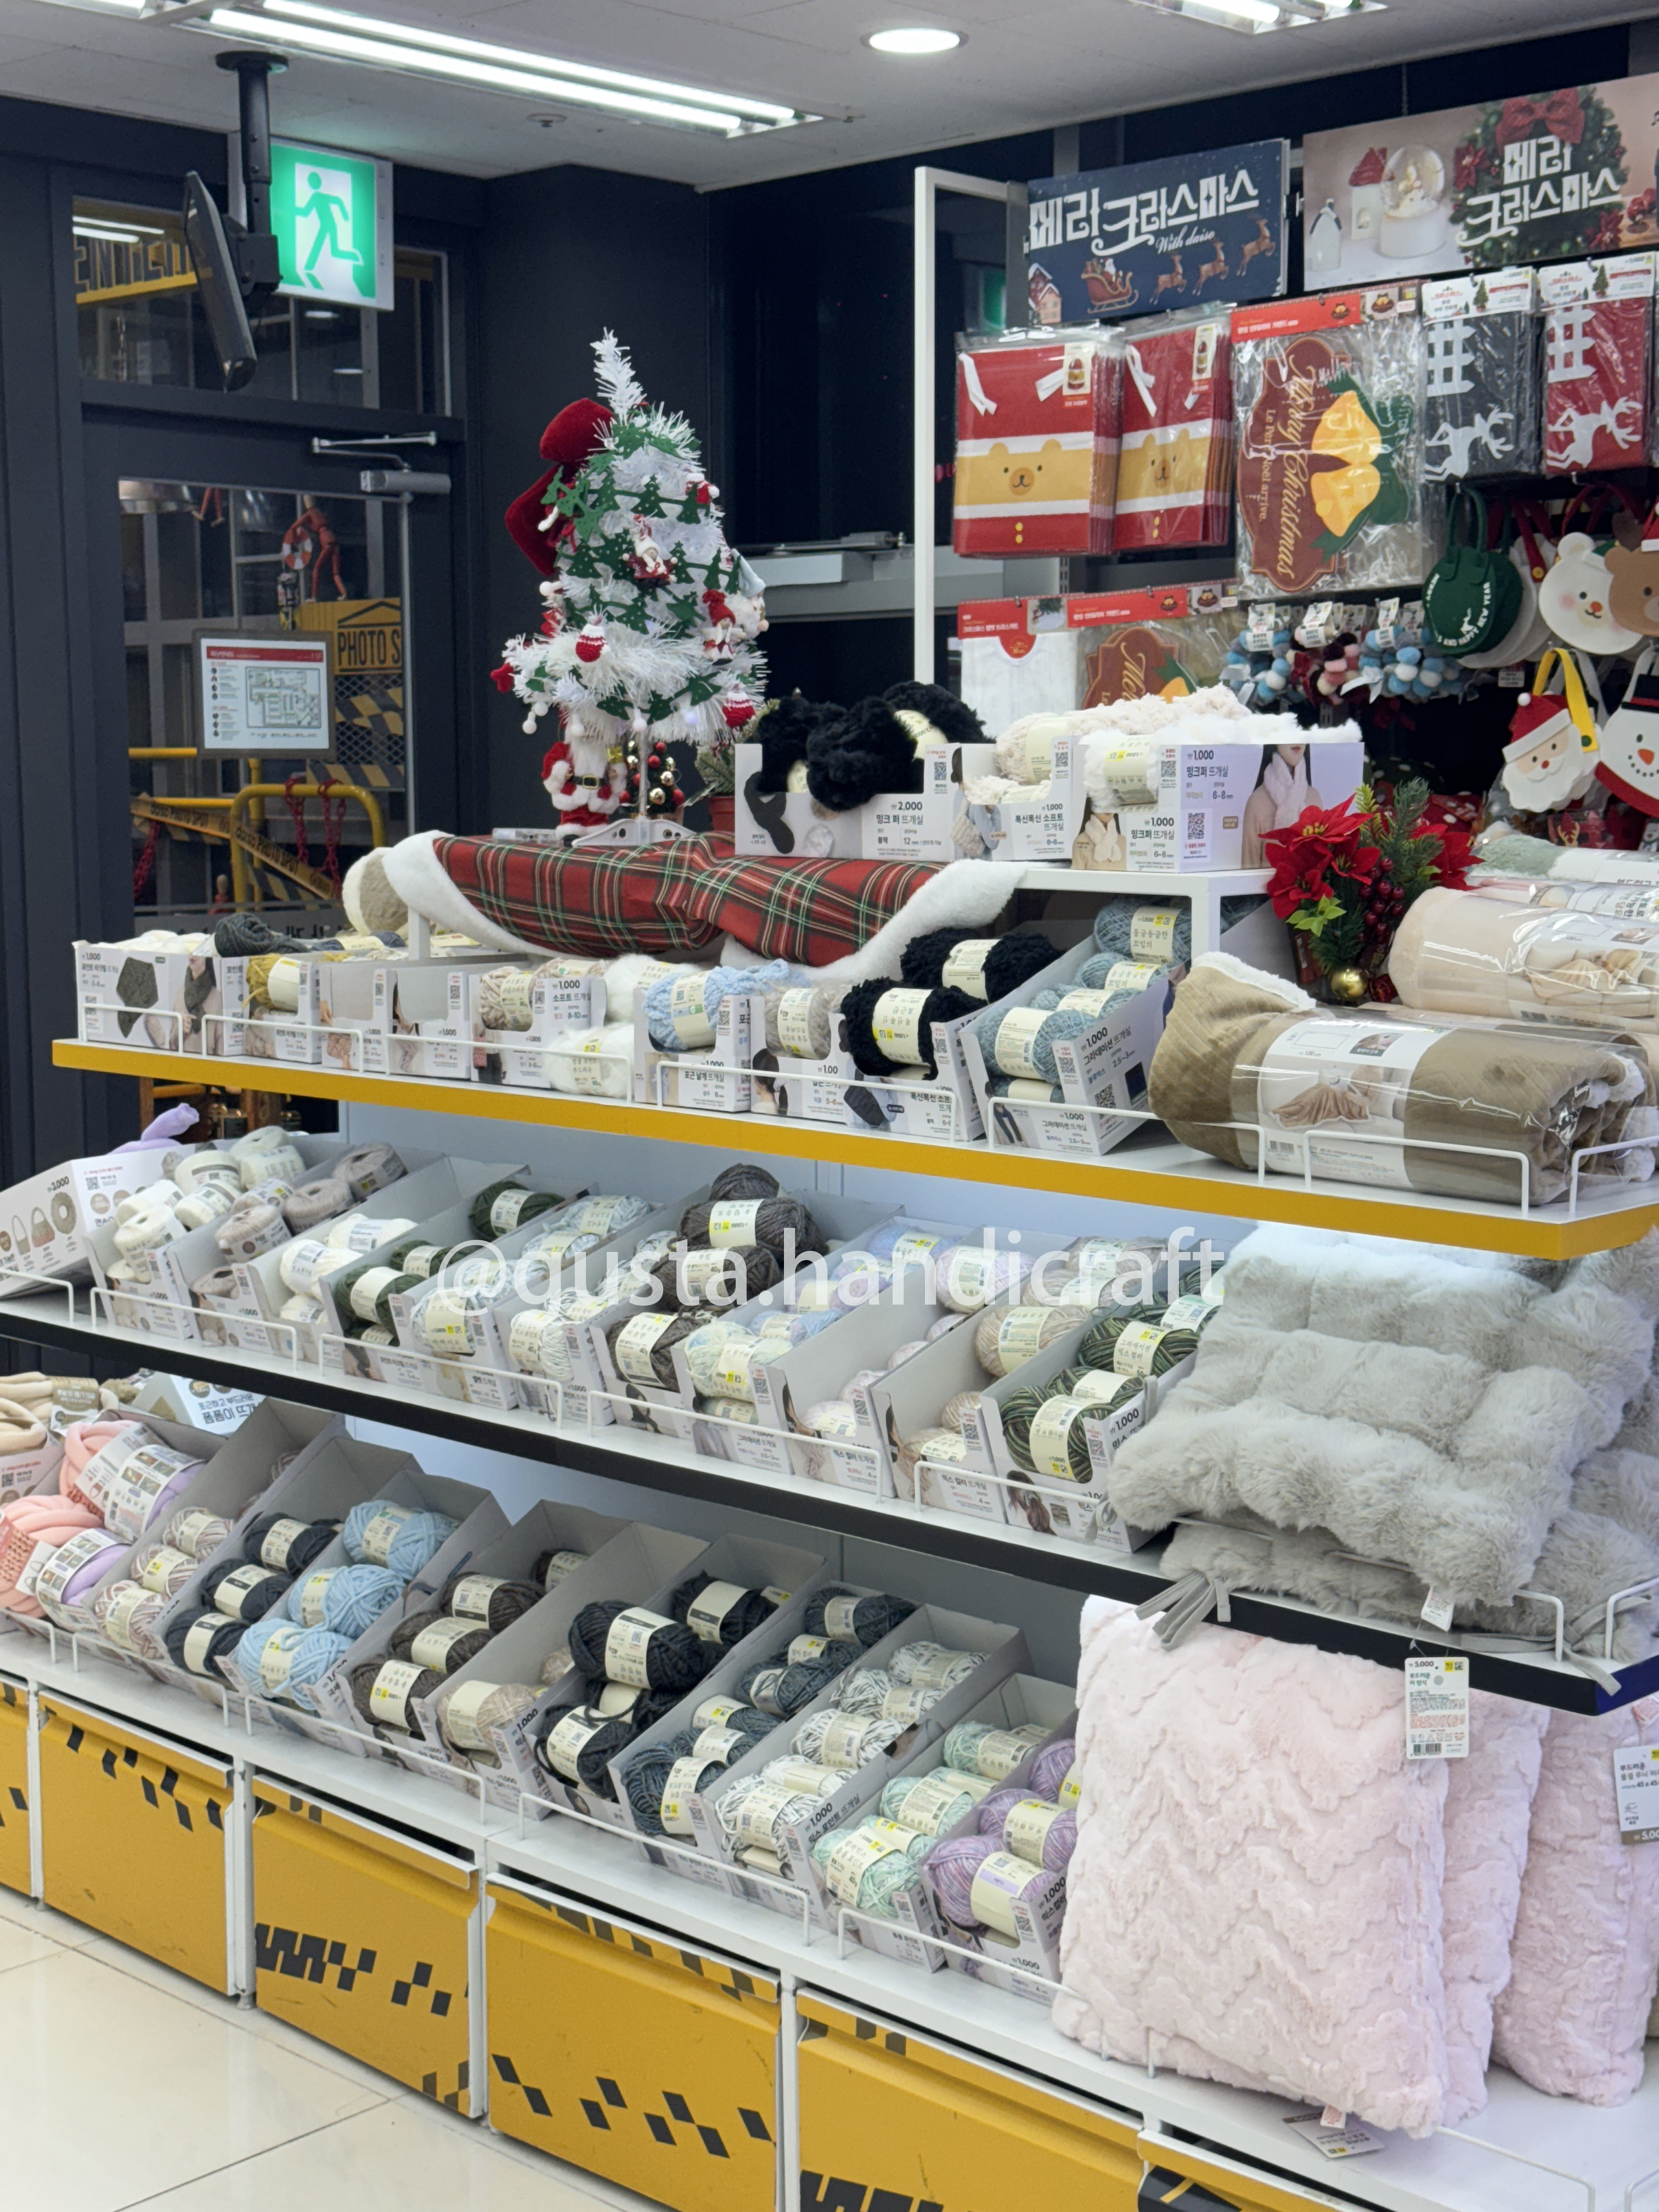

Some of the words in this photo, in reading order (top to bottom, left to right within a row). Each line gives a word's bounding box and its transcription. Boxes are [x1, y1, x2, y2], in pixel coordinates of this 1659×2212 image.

[1029, 187, 1100, 250] 메리
[1155, 225, 1184, 254] With
[1185, 229, 1216, 247] daiso
[1276, 449, 1310, 579] Christmas
[1443, 637, 1457, 646] AND
[337, 630, 387, 667] PHOTO
[1209, 766, 1228, 777] 뜨개실
[876, 814, 891, 825] 밍크
[901, 814, 923, 825] 뜨개실
[1043, 814, 1064, 822] 소프트
[1044, 823, 1064, 832] 뜨개실
[1154, 830, 1175, 840] 뜨개실
[552, 979, 580, 990] ₩1,000
[553, 993, 572, 1002] 소프트
[1081, 1026, 1108, 1052] ₩1,000
[708, 1073, 725, 1083] 뜨개실
[938, 1095, 952, 1104] 소프
[939, 1104, 952, 1113] 뜨개
[1109, 1407, 1139, 1435] ₩1,000
[805, 1803, 833, 1833] ₩1,000
[1038, 1876, 1066, 1909] ₩1,000
